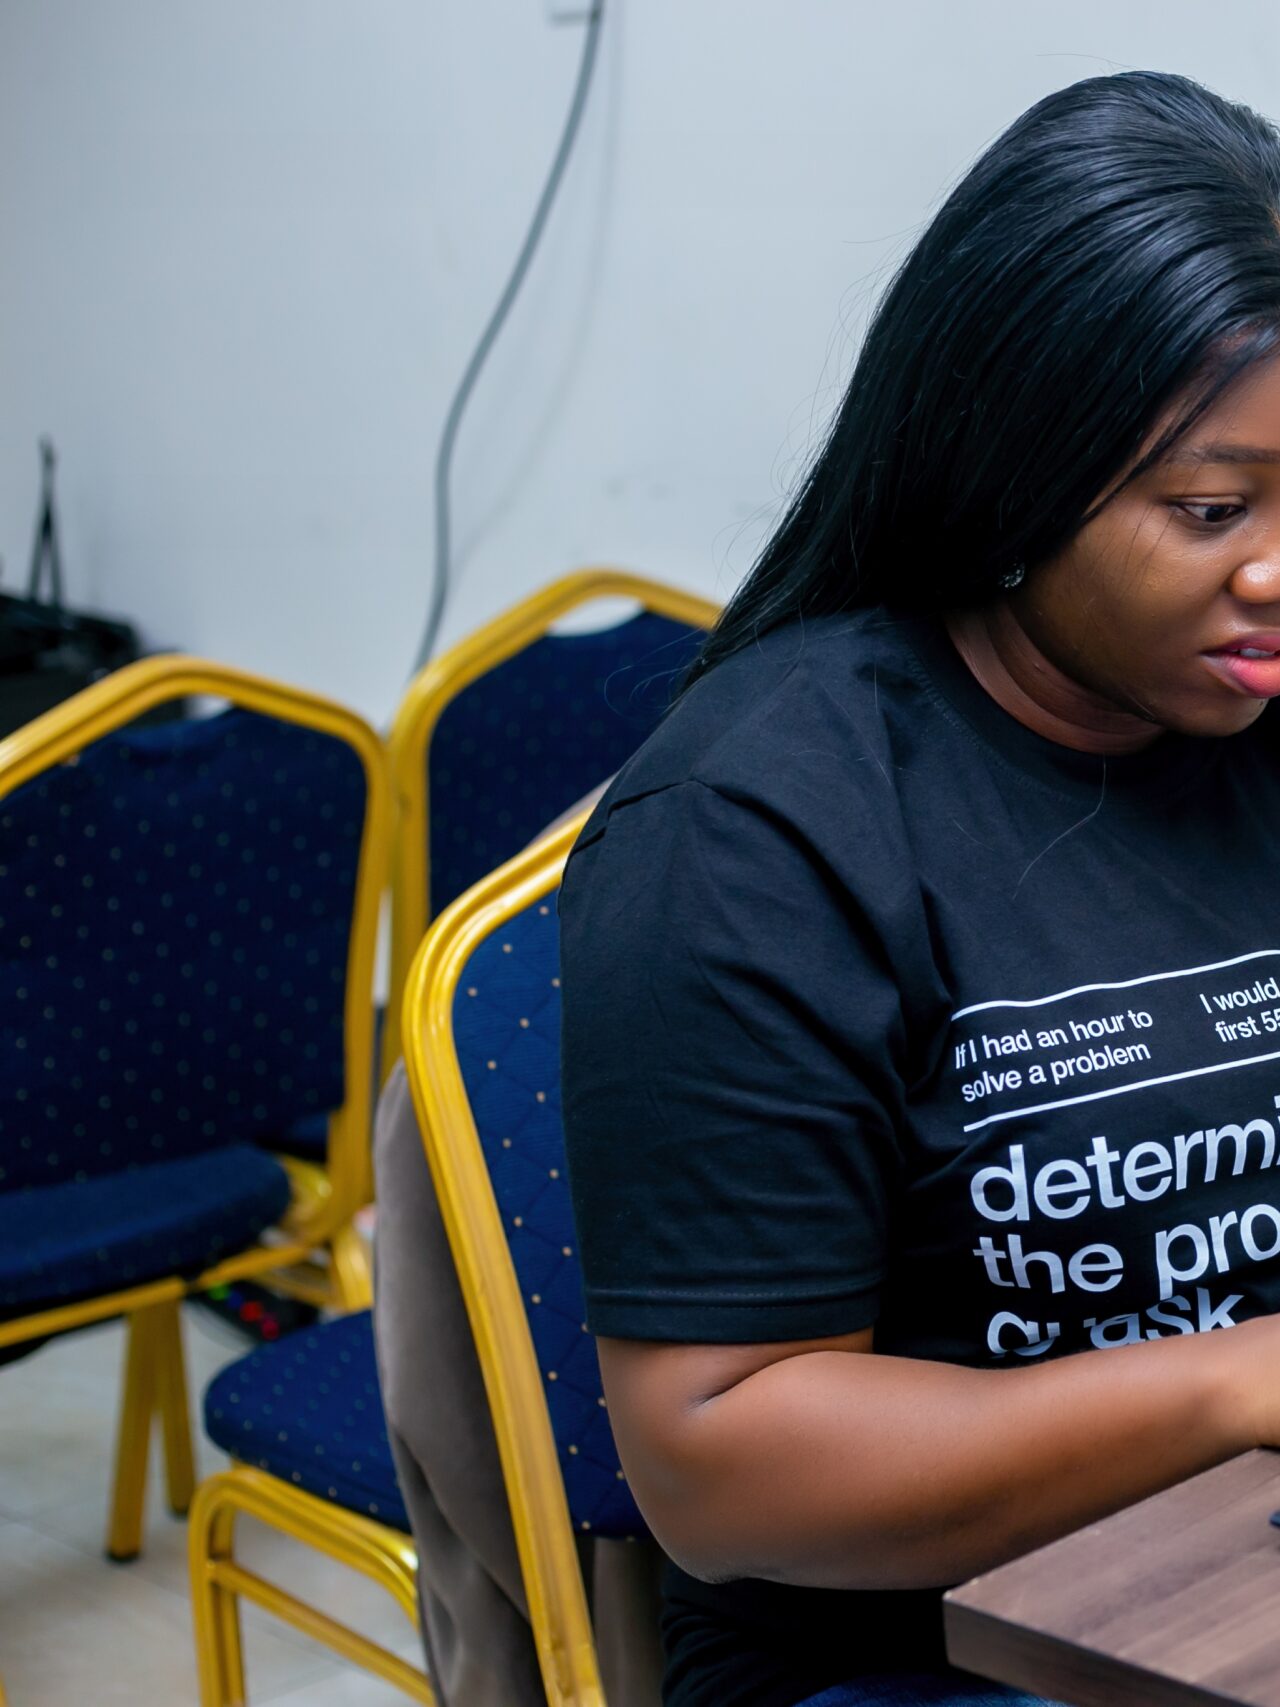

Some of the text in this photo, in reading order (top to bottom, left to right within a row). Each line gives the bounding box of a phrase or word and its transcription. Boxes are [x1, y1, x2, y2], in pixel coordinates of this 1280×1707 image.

[1199, 993, 1213, 1014] I
[1215, 1016, 1262, 1043] first
[955, 1009, 1154, 1070] If I had an hour to
[961, 1043, 1152, 1102] solve a problem
[972, 1233, 1125, 1294] the
